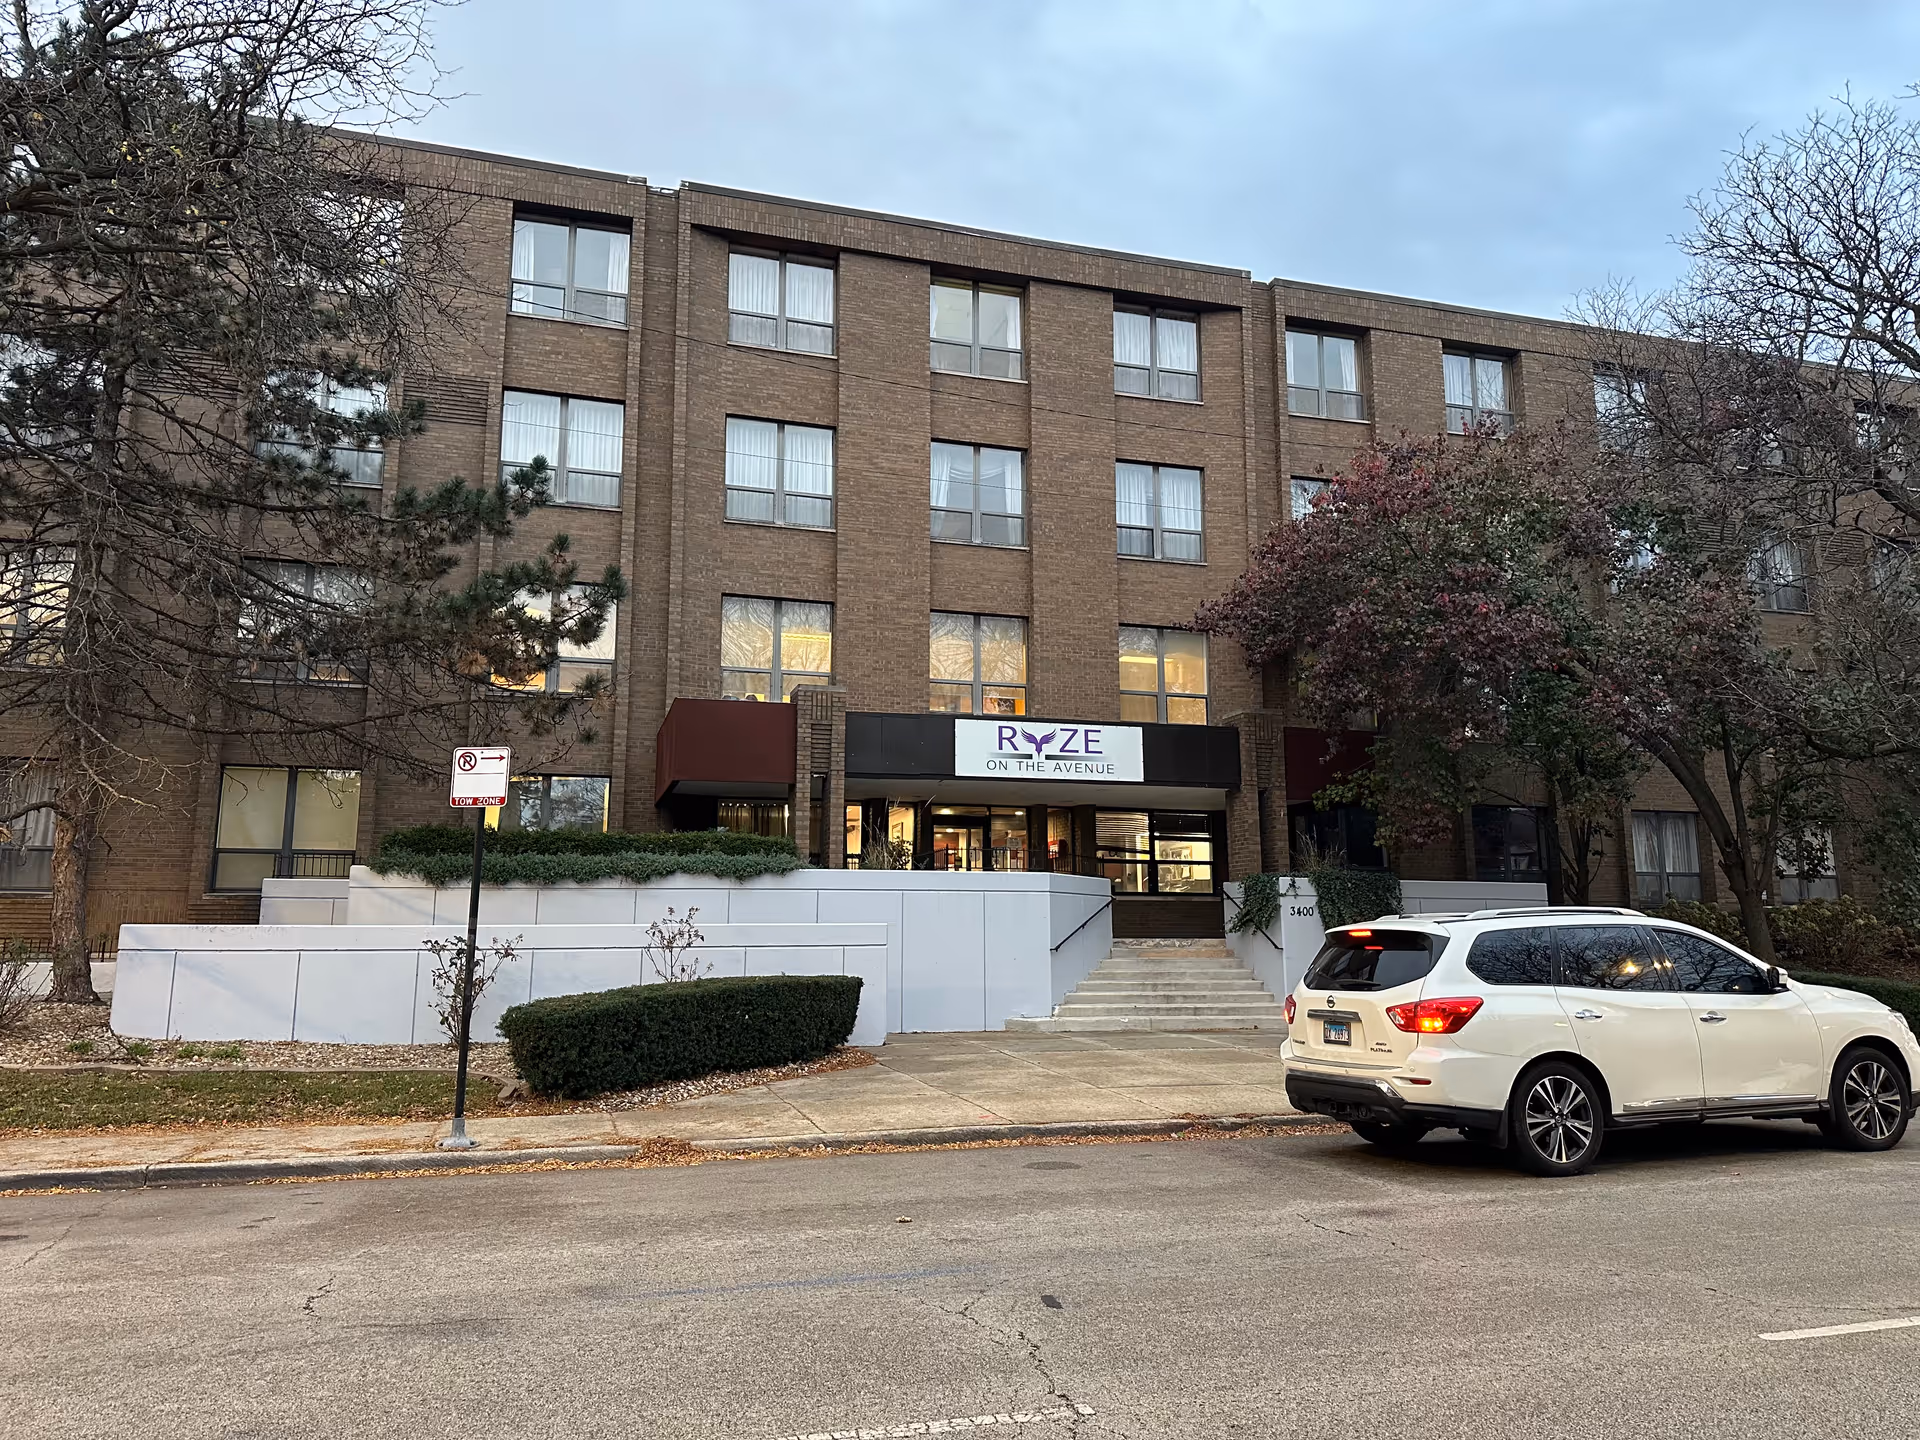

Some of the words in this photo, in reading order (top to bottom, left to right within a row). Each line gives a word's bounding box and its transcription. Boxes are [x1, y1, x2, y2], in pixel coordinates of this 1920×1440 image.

[998, 725, 1103, 757] RYZE
[986, 759, 1008, 771] ON
[1016, 760, 1045, 772] THE
[1053, 762, 1115, 774] AVENUE
[454, 797, 473, 805] TOW
[476, 797, 501, 805] ZONE
[1290, 906, 1314, 917] 3400
